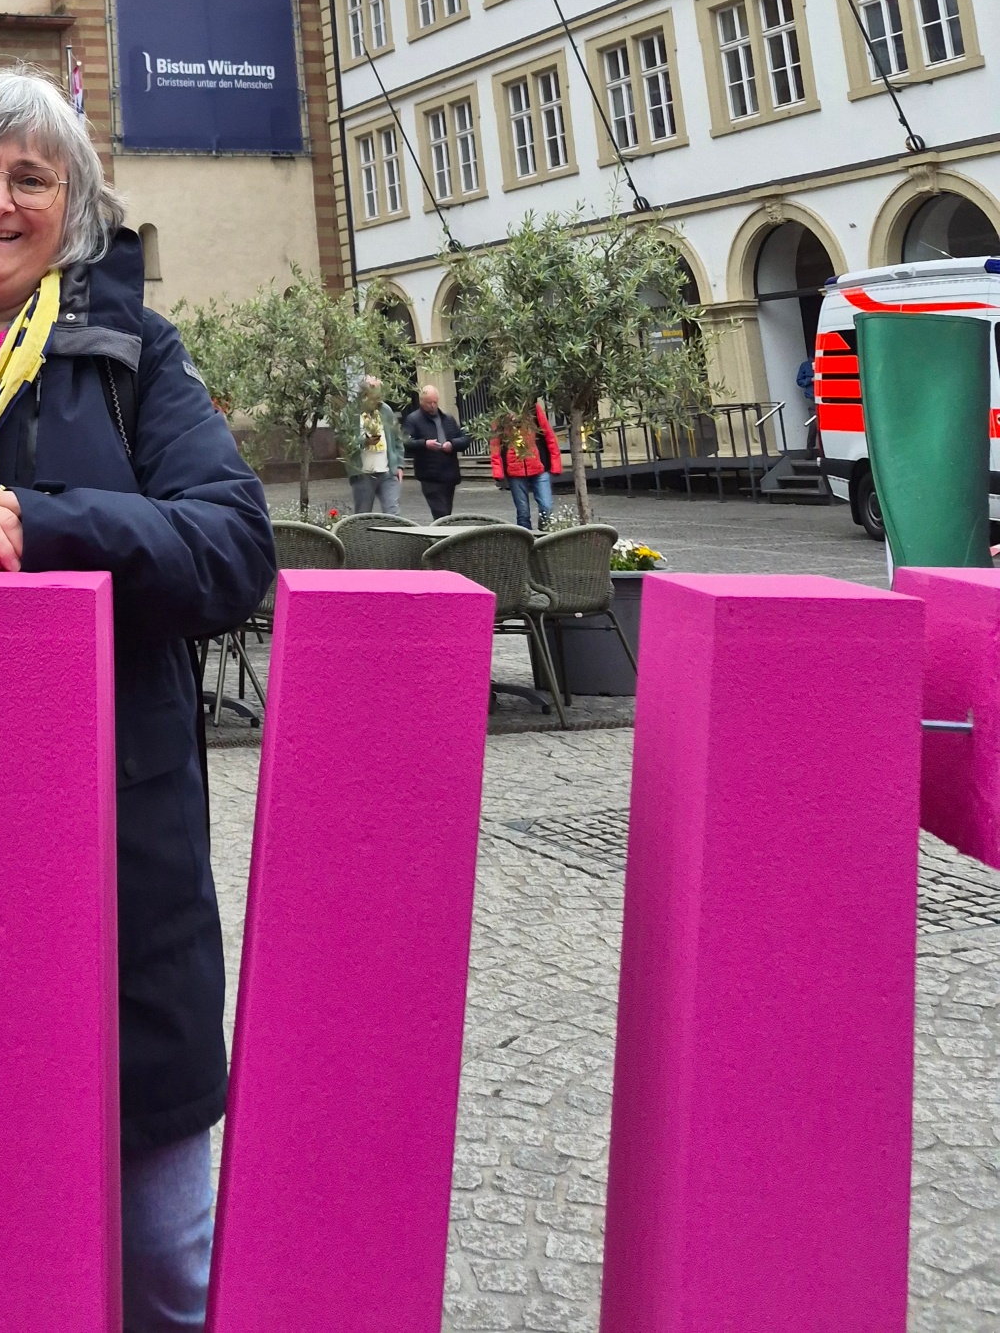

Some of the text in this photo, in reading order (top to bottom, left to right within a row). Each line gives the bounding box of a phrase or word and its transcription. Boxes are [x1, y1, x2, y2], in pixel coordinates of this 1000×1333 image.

[156, 58, 276, 80] Bistum Würzburg
[156, 77, 273, 90] Christsein unter den Menschen
